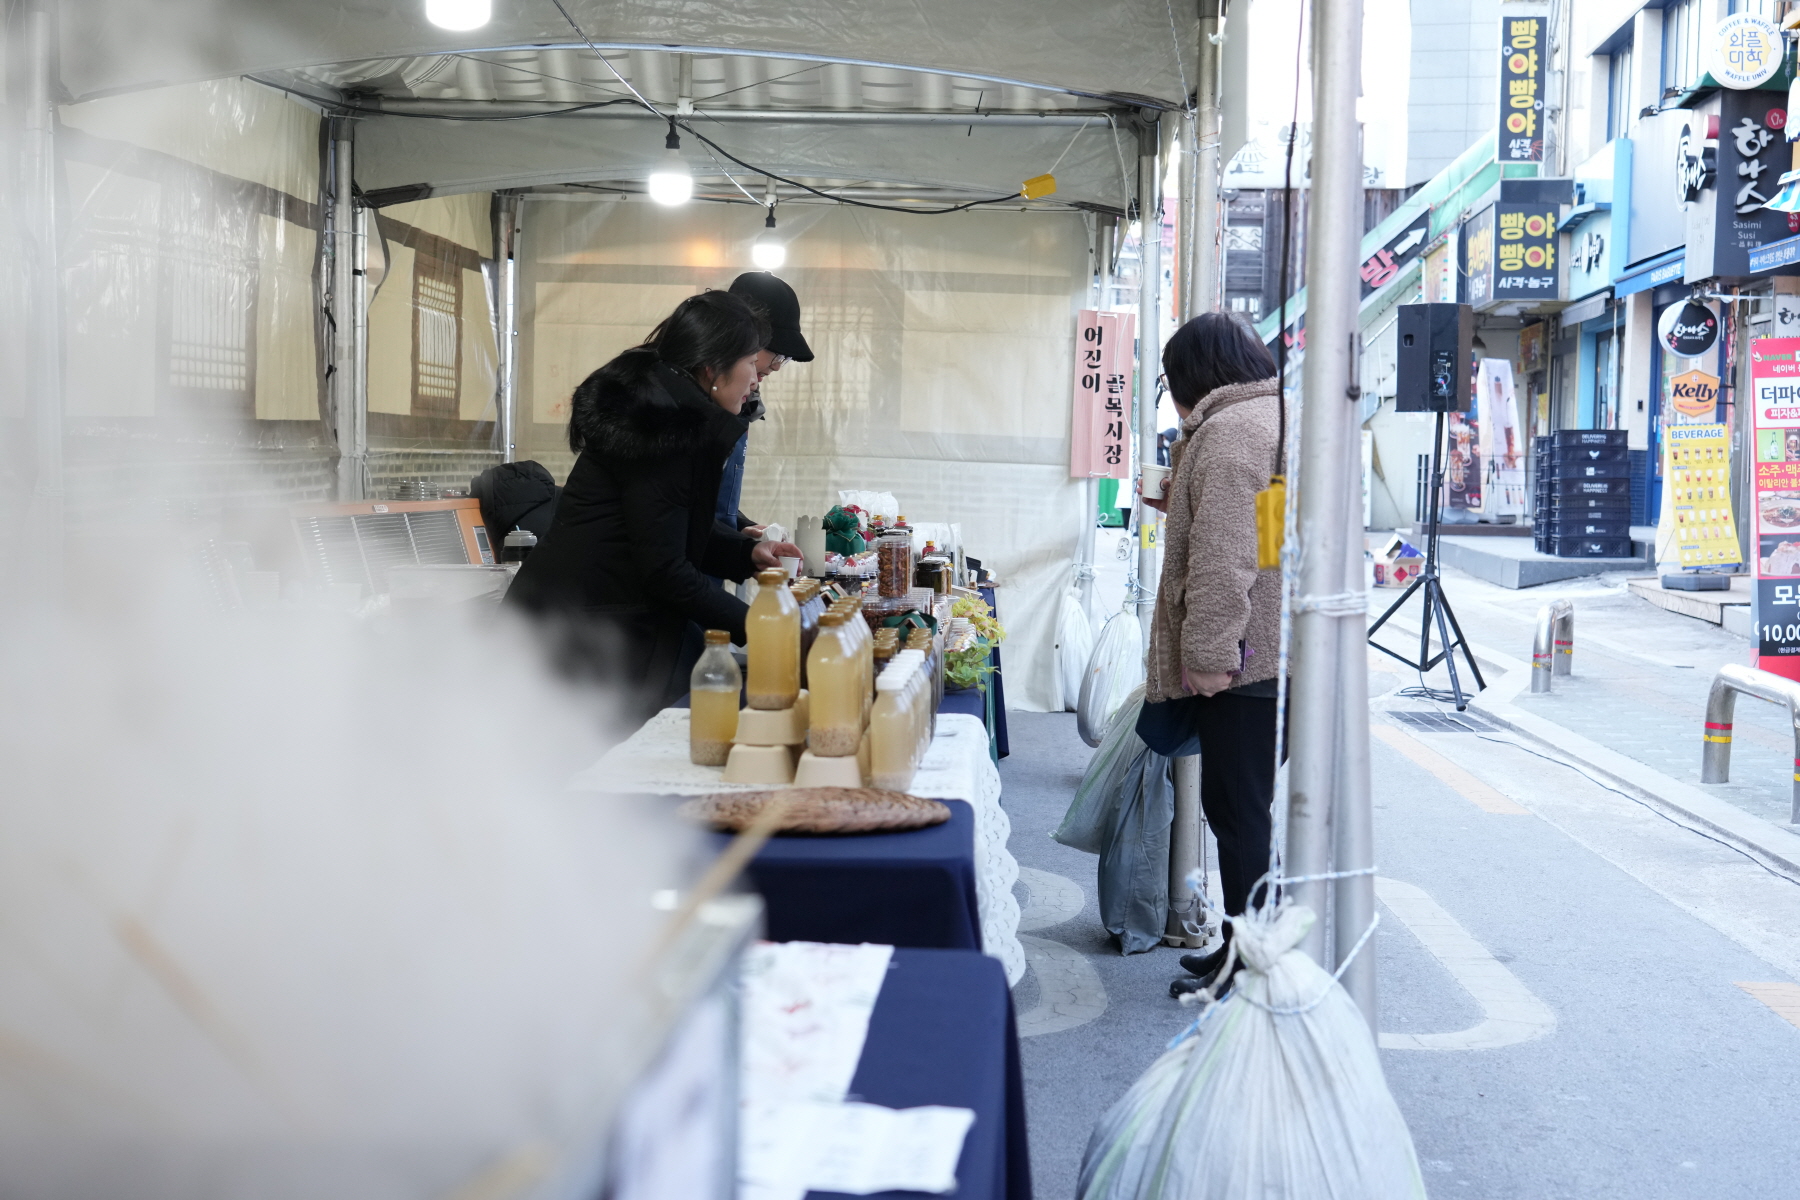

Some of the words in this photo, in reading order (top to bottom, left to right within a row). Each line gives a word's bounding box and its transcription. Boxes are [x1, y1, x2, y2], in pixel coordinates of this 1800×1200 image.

[1718, 19, 1741, 37] COFFEE
[1751, 18, 1775, 37] WAFFLE
[1729, 28, 1763, 48] 와플
[1729, 49, 1763, 71] 대학
[1725, 69, 1750, 82] WAFFLE
[1731, 117, 1773, 214] 하나스
[1500, 212, 1555, 240] 빵야
[1733, 220, 1762, 229] Sasimi
[1738, 231, 1756, 240] Susi
[1500, 243, 1555, 271] 빵야
[1081, 325, 1104, 394] 어진이
[1773, 364, 1795, 373] 네이버
[1672, 383, 1718, 402] Kelly
[1103, 373, 1126, 465] 골목시장
[1771, 408, 1800, 419] 피자&
[1671, 428, 1724, 440] BEVERAGE
[1773, 585, 1800, 607] 모
